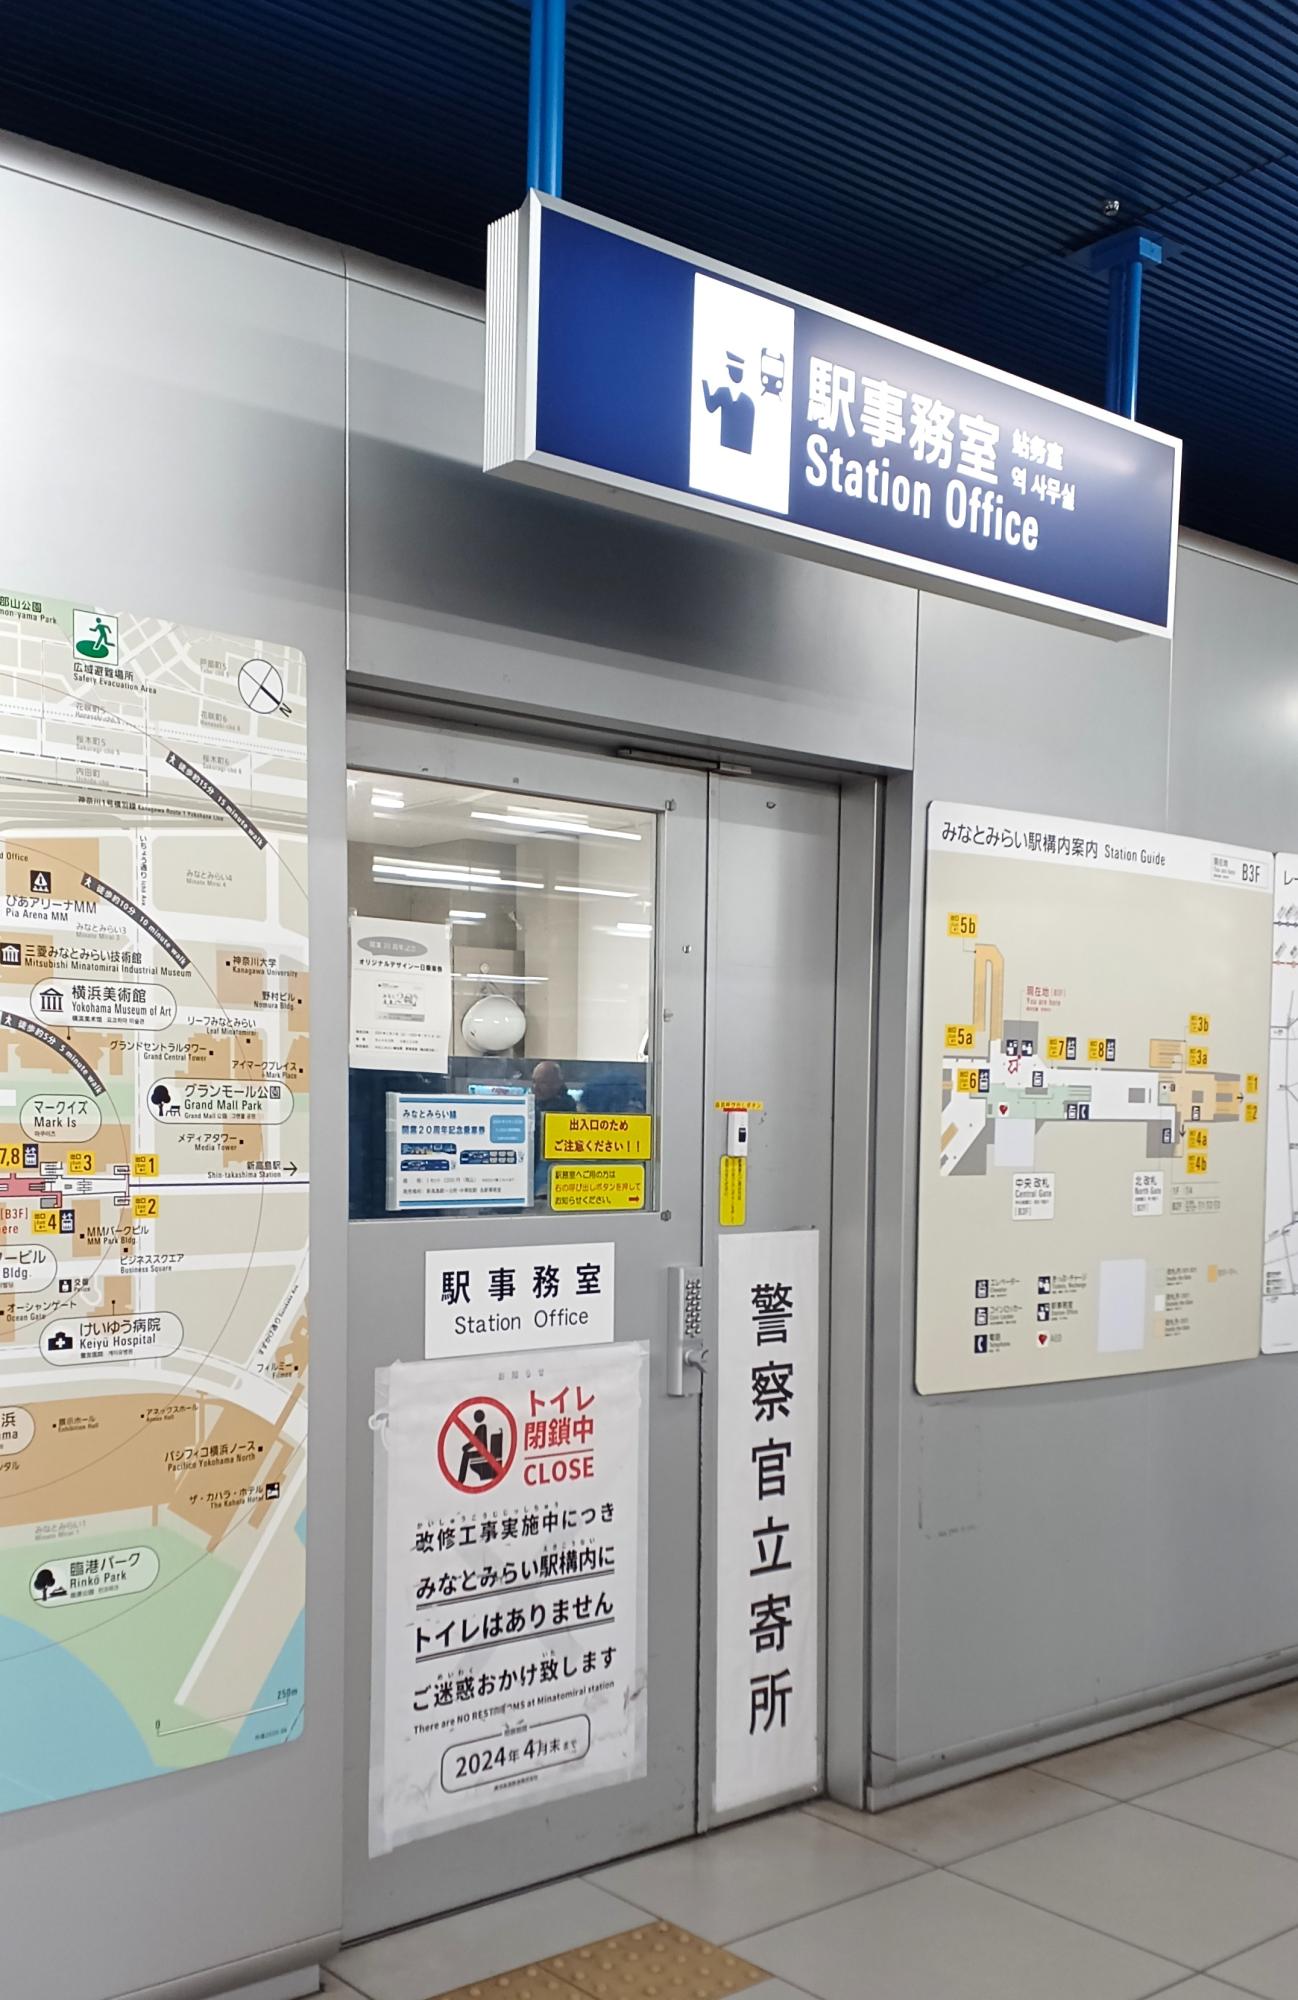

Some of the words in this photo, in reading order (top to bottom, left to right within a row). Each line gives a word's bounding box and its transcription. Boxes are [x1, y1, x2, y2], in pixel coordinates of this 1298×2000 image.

[807, 356, 999, 485] 駅事務室
[805, 433, 931, 519] Station
[945, 479, 1039, 550] Office
[1011, 466, 1026, 495] 역
[1031, 474, 1075, 511] 사무실
[40, 614, 57, 624] Park
[73, 662, 134, 682] 広域避難場所
[73, 673, 97, 685] Safety
[99, 678, 139, 692] Evacuation
[141, 684, 157, 695] Area
[279, 702, 292, 718] N
[225, 804, 248, 830] minute
[247, 828, 263, 846] walk
[942, 821, 1098, 860] みなとみらい駅構内案内
[1104, 844, 1138, 864] Station
[1140, 848, 1166, 867] Guide
[6, 852, 28, 862] Office
[1242, 863, 1261, 884] B3F
[6, 894, 97, 914] ぴあアリーナMM
[6, 908, 19, 918] Pia
[23, 910, 48, 920] Arena
[51, 912, 69, 922] MM
[960, 917, 976, 934] 5b
[148, 924, 171, 948] minute
[171, 947, 187, 966] walk
[24, 944, 142, 964] 三菱みなとみらい技術館
[233, 955, 276, 968] 神奈川大学
[24, 957, 68, 969] Mitsubishi
[71, 960, 119, 972] Minatomirai
[121, 964, 158, 975] Industrial
[161, 966, 192, 977] Museum
[232, 966, 264, 975] Kanagawa
[266, 968, 298, 977] University
[71, 985, 147, 1003] 横浜美術館
[262, 991, 295, 1002] 野村ビル
[71, 1001, 112, 1013] Yokohama
[114, 1003, 148, 1015] Museum
[149, 1004, 157, 1015] of
[160, 1005, 172, 1017] Art
[254, 1001, 278, 1009] Nomura
[187, 1016, 256, 1028] リーフみなとみらい
[1197, 1016, 1209, 1032] 3b
[958, 1029, 973, 1045] 5a
[110, 1040, 206, 1053] グランドセントラルタワー
[1058, 1040, 1064, 1056] 7
[1098, 1042, 1104, 1057] 8
[143, 1053, 162, 1061] Grand
[163, 1053, 186, 1061] Central
[188, 1054, 207, 1062] Tower
[1196, 1049, 1208, 1064] 3a
[65, 1050, 89, 1075] minute
[87, 1074, 102, 1094] walk
[232, 1060, 297, 1071] アイマークプレイス
[970, 1072, 976, 1089] 6
[185, 1084, 280, 1099] グランモール公園
[34, 1101, 88, 1115] マークイズ
[184, 1099, 213, 1110] Grand
[217, 1100, 238, 1110] Mall
[242, 1100, 262, 1110] Park
[34, 1116, 63, 1127] Mark
[67, 1117, 76, 1127] Is
[403, 1109, 457, 1119] みなとみらい線
[569, 1118, 628, 1131] 出入口のため
[178, 1133, 238, 1143] メディアタワー
[83, 1154, 92, 1171] 3
[148, 1157, 154, 1173] 1
[247, 1161, 281, 1170] 新高島駅
[1016, 1178, 1049, 1188] 中央改札
[148, 1198, 156, 1214] 2
[48, 1214, 57, 1230] 4
[87, 1226, 149, 1237] MMパークビル
[120, 1253, 184, 1265] ビジネススクエア
[120, 1266, 148, 1274] Business
[441, 1262, 601, 1306] 駅事務室
[7, 1301, 77, 1313] オーシャンゲート
[80, 1317, 161, 1336] けいゆう病院
[455, 1313, 521, 1335] Station
[534, 1308, 589, 1328] Office
[113, 1334, 156, 1347] Hospital
[257, 1361, 292, 1373] フィルミー
[530, 1386, 595, 1417] トイレ
[524, 1414, 594, 1451] 閉鎖中
[164, 1441, 256, 1462] パシフィコ横浜ノース
[199, 1457, 234, 1468] Yokohama
[236, 1454, 256, 1463] North
[524, 1458, 594, 1486] CLOSE
[189, 1486, 263, 1505] ザ・カハラ・ホテル
[749, 1282, 794, 1736] 警察官立寄所
[415, 1502, 615, 1553] 改修工事実施中につき
[70, 1552, 140, 1577] 臨港パーク
[416, 1546, 615, 1599] みなとみらい駅構内に
[104, 1570, 127, 1583] Park
[416, 1591, 614, 1653] トイレはありません
[412, 1646, 617, 1712] ご迷惑おかけ致します
[277, 1688, 298, 1700] 250m
[414, 1723, 439, 1735] There
[441, 1719, 454, 1729] are
[457, 1713, 470, 1725] NO
[527, 1700, 535, 1709] at
[587, 1681, 615, 1694] station
[455, 1739, 578, 1778] 2024年4月末まで
